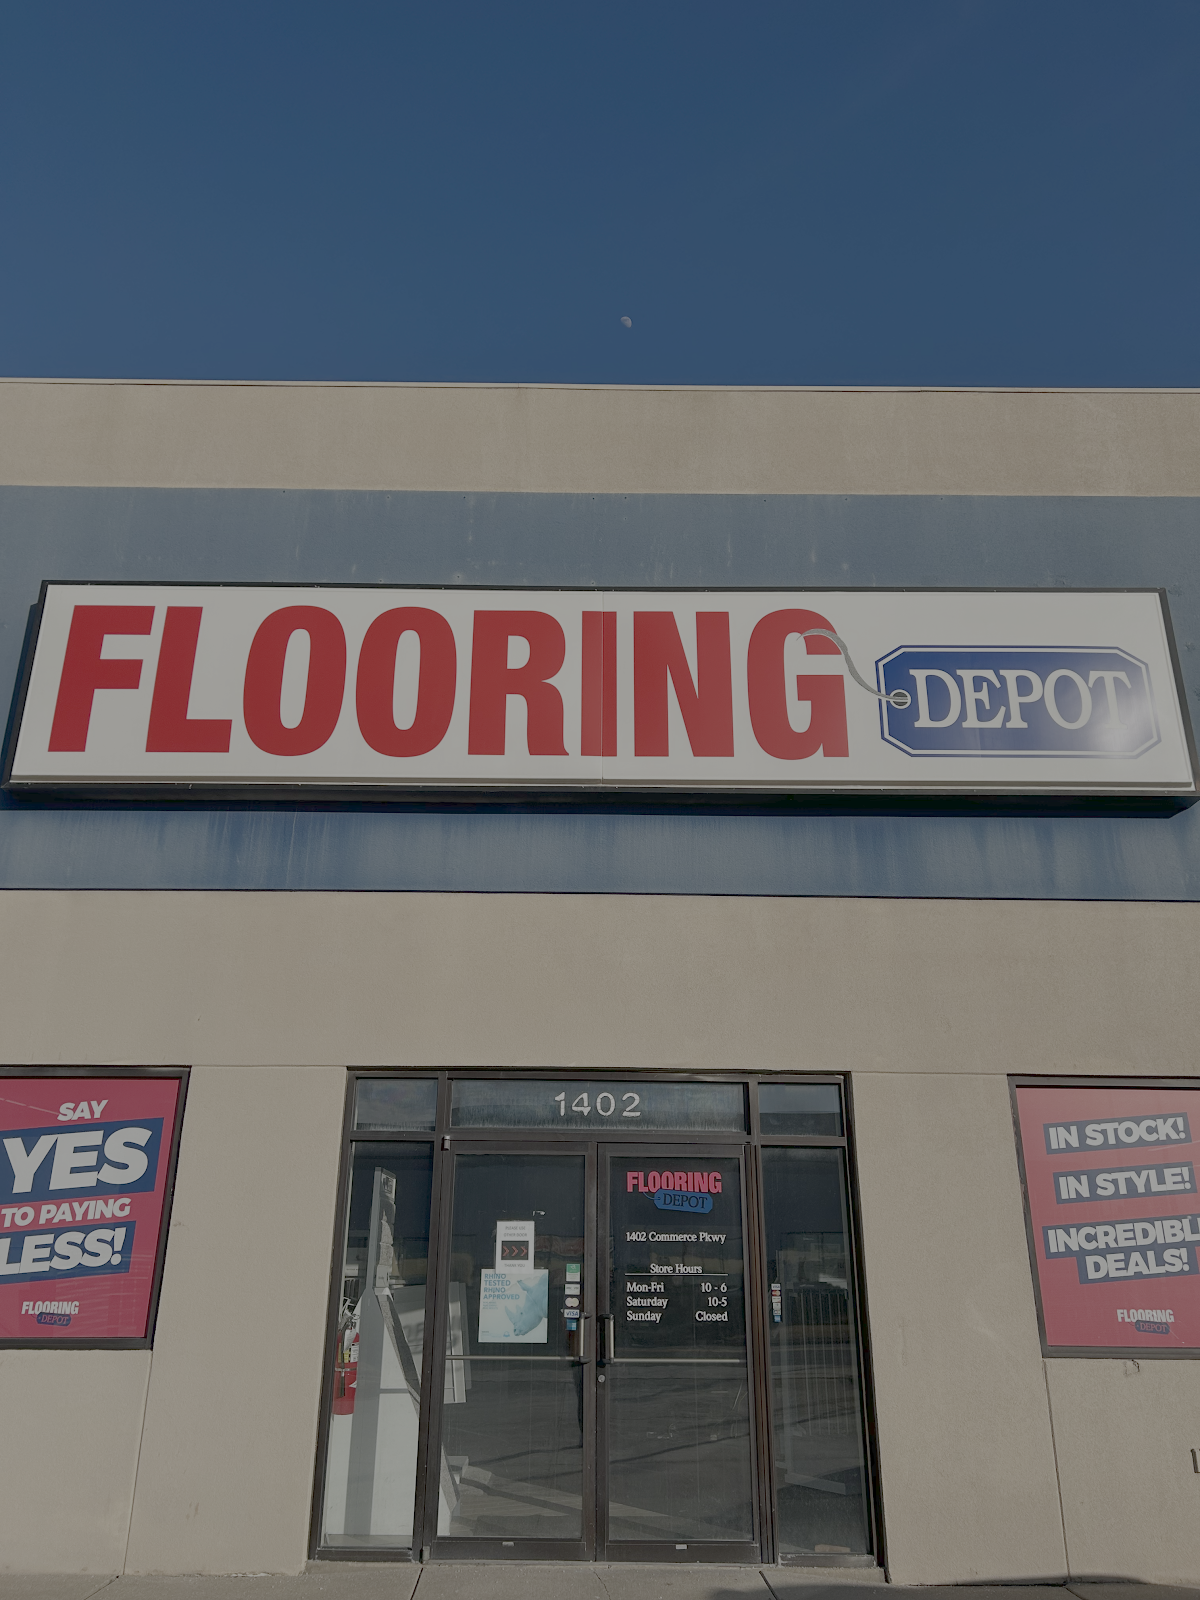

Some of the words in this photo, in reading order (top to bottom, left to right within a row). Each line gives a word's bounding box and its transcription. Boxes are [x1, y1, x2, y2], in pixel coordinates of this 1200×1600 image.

[48, 605, 849, 761] FLOORING
[909, 668, 1132, 730] DEPOT
[57, 1099, 108, 1121] SAY
[554, 1092, 641, 1117] 1402
[1049, 1125, 1080, 1150] IN
[1085, 1117, 1186, 1147] STOCK!
[2, 1127, 152, 1194] YES
[626, 1171, 722, 1194] FLOORING
[1058, 1175, 1090, 1200] IN
[1096, 1167, 1192, 1197] STYLE!
[662, 1192, 708, 1209] DEPOT
[1, 1207, 34, 1228] TO
[39, 1198, 131, 1225] PAYING
[626, 1232, 647, 1242] 1402
[648, 1232, 697, 1242] Commerce
[699, 1232, 726, 1244] Pkwy
[1047, 1217, 1200, 1253] INCREDIBL
[0, 1227, 126, 1276] LESS!
[650, 1263, 674, 1273] Store
[675, 1264, 702, 1274] Hours
[1086, 1248, 1190, 1280] DEALS!
[626, 1282, 665, 1292] Mon-Fri
[701, 1282, 712, 1293] 10
[720, 1283, 727, 1293] 6
[21, 1301, 80, 1316] FLOORING
[626, 1296, 668, 1309] Saturday
[707, 1297, 728, 1307] 10-5
[41, 1314, 69, 1325] DEPOT
[626, 1311, 662, 1323] Sunday
[695, 1311, 728, 1321] Closed
[1117, 1309, 1175, 1323] FLOORING
[1139, 1322, 1167, 1333] DEPOT
